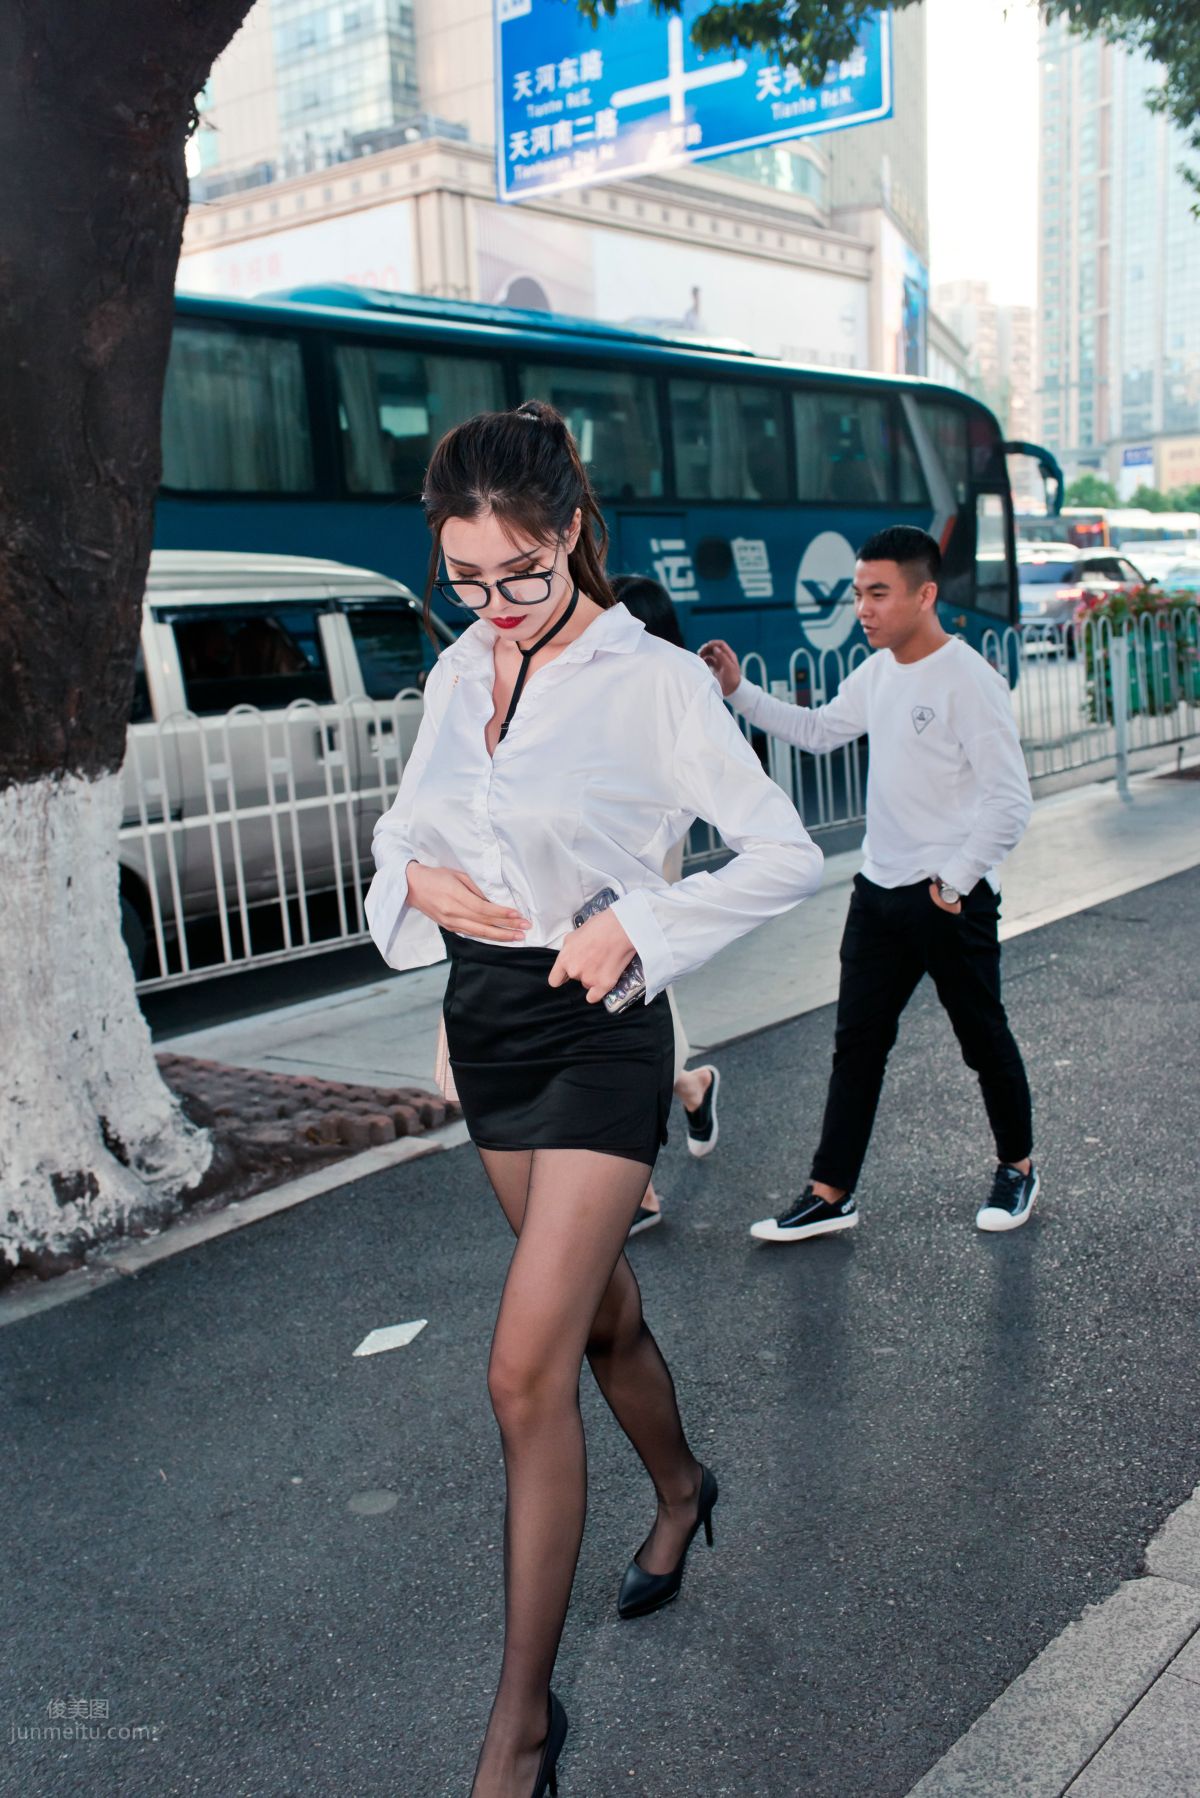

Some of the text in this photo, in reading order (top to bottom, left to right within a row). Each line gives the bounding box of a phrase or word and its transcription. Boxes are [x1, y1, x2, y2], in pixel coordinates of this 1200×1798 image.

[512, 48, 603, 101] 天河东路
[755, 45, 867, 101] 天河路
[508, 107, 617, 161] 天河南二路
